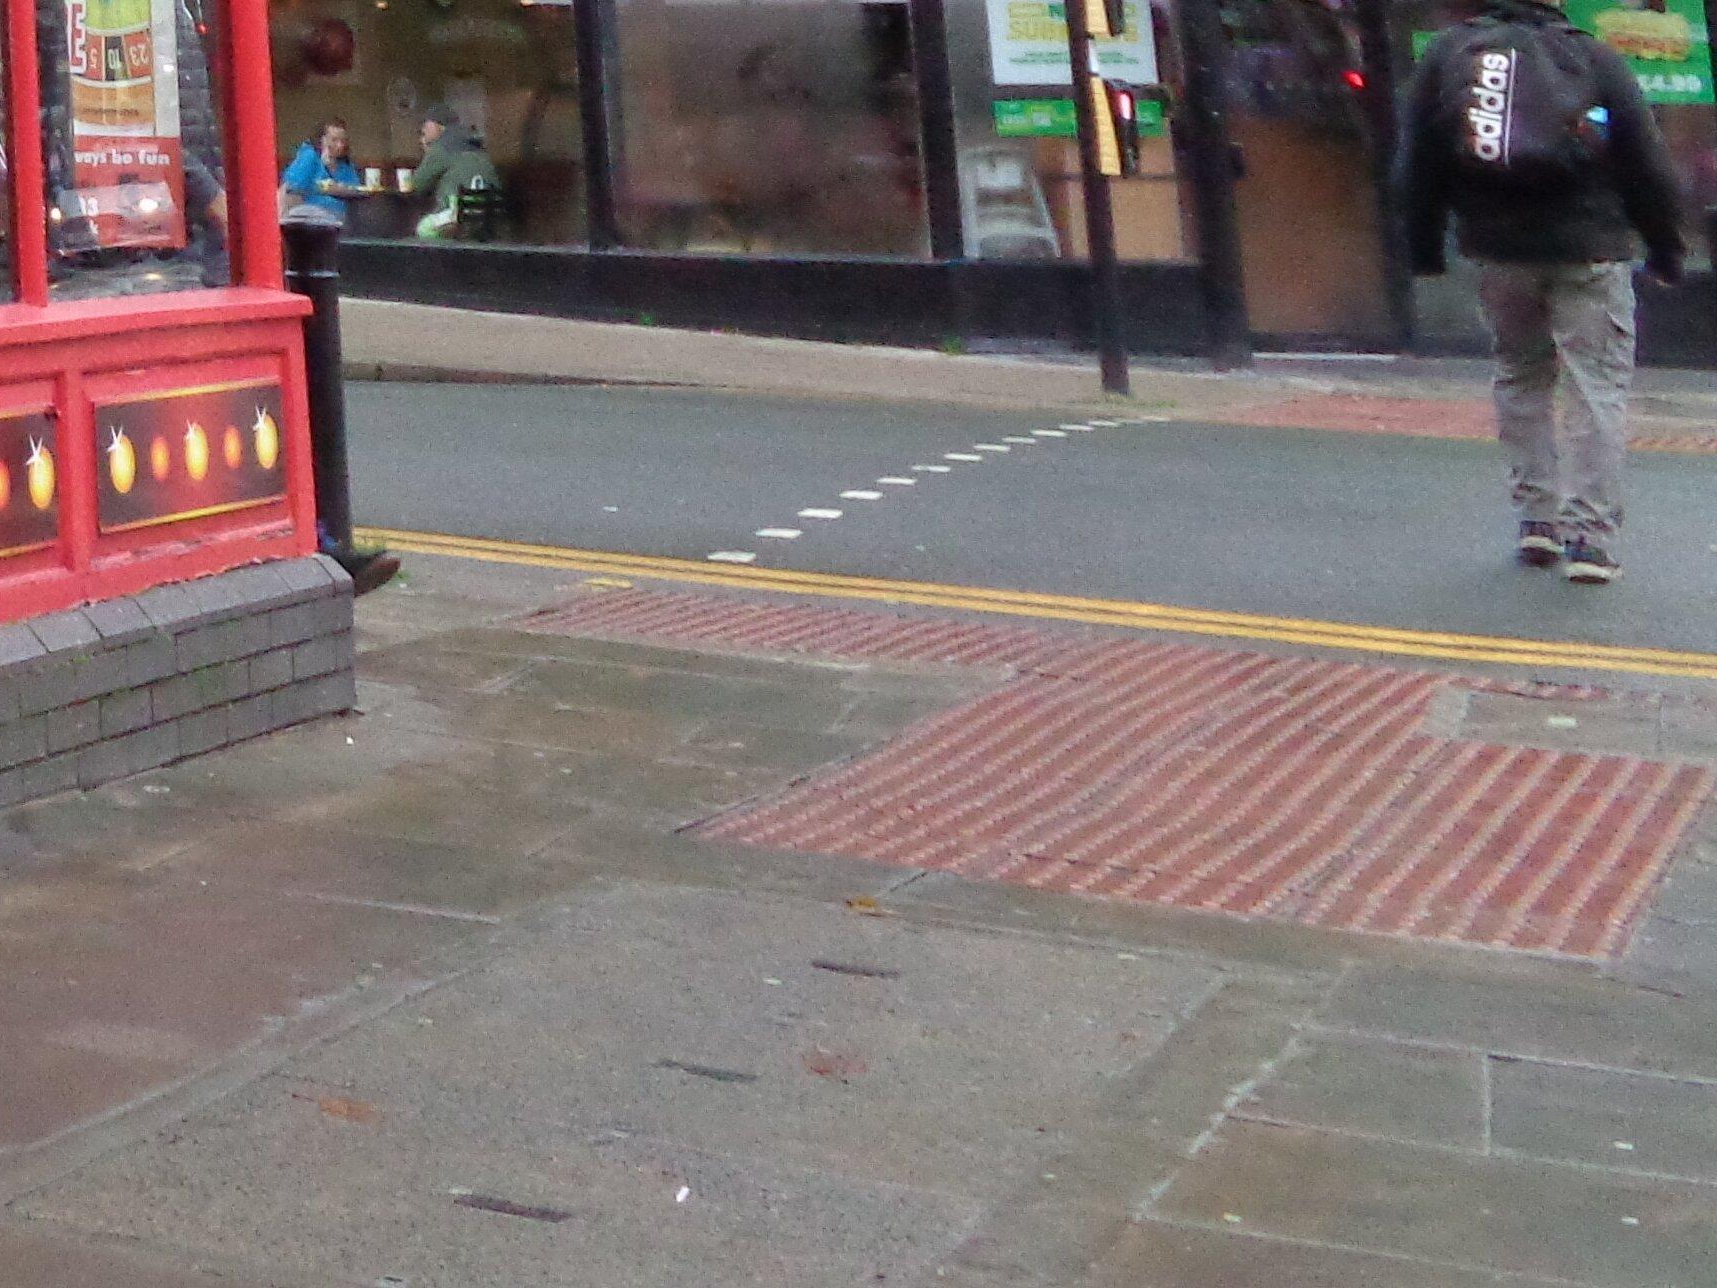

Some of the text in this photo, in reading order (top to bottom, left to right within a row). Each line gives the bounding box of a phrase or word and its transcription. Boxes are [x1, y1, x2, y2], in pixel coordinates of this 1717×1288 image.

[1467, 53, 1510, 161] adidas
[111, 148, 133, 165] be
[137, 149, 170, 166] fun
